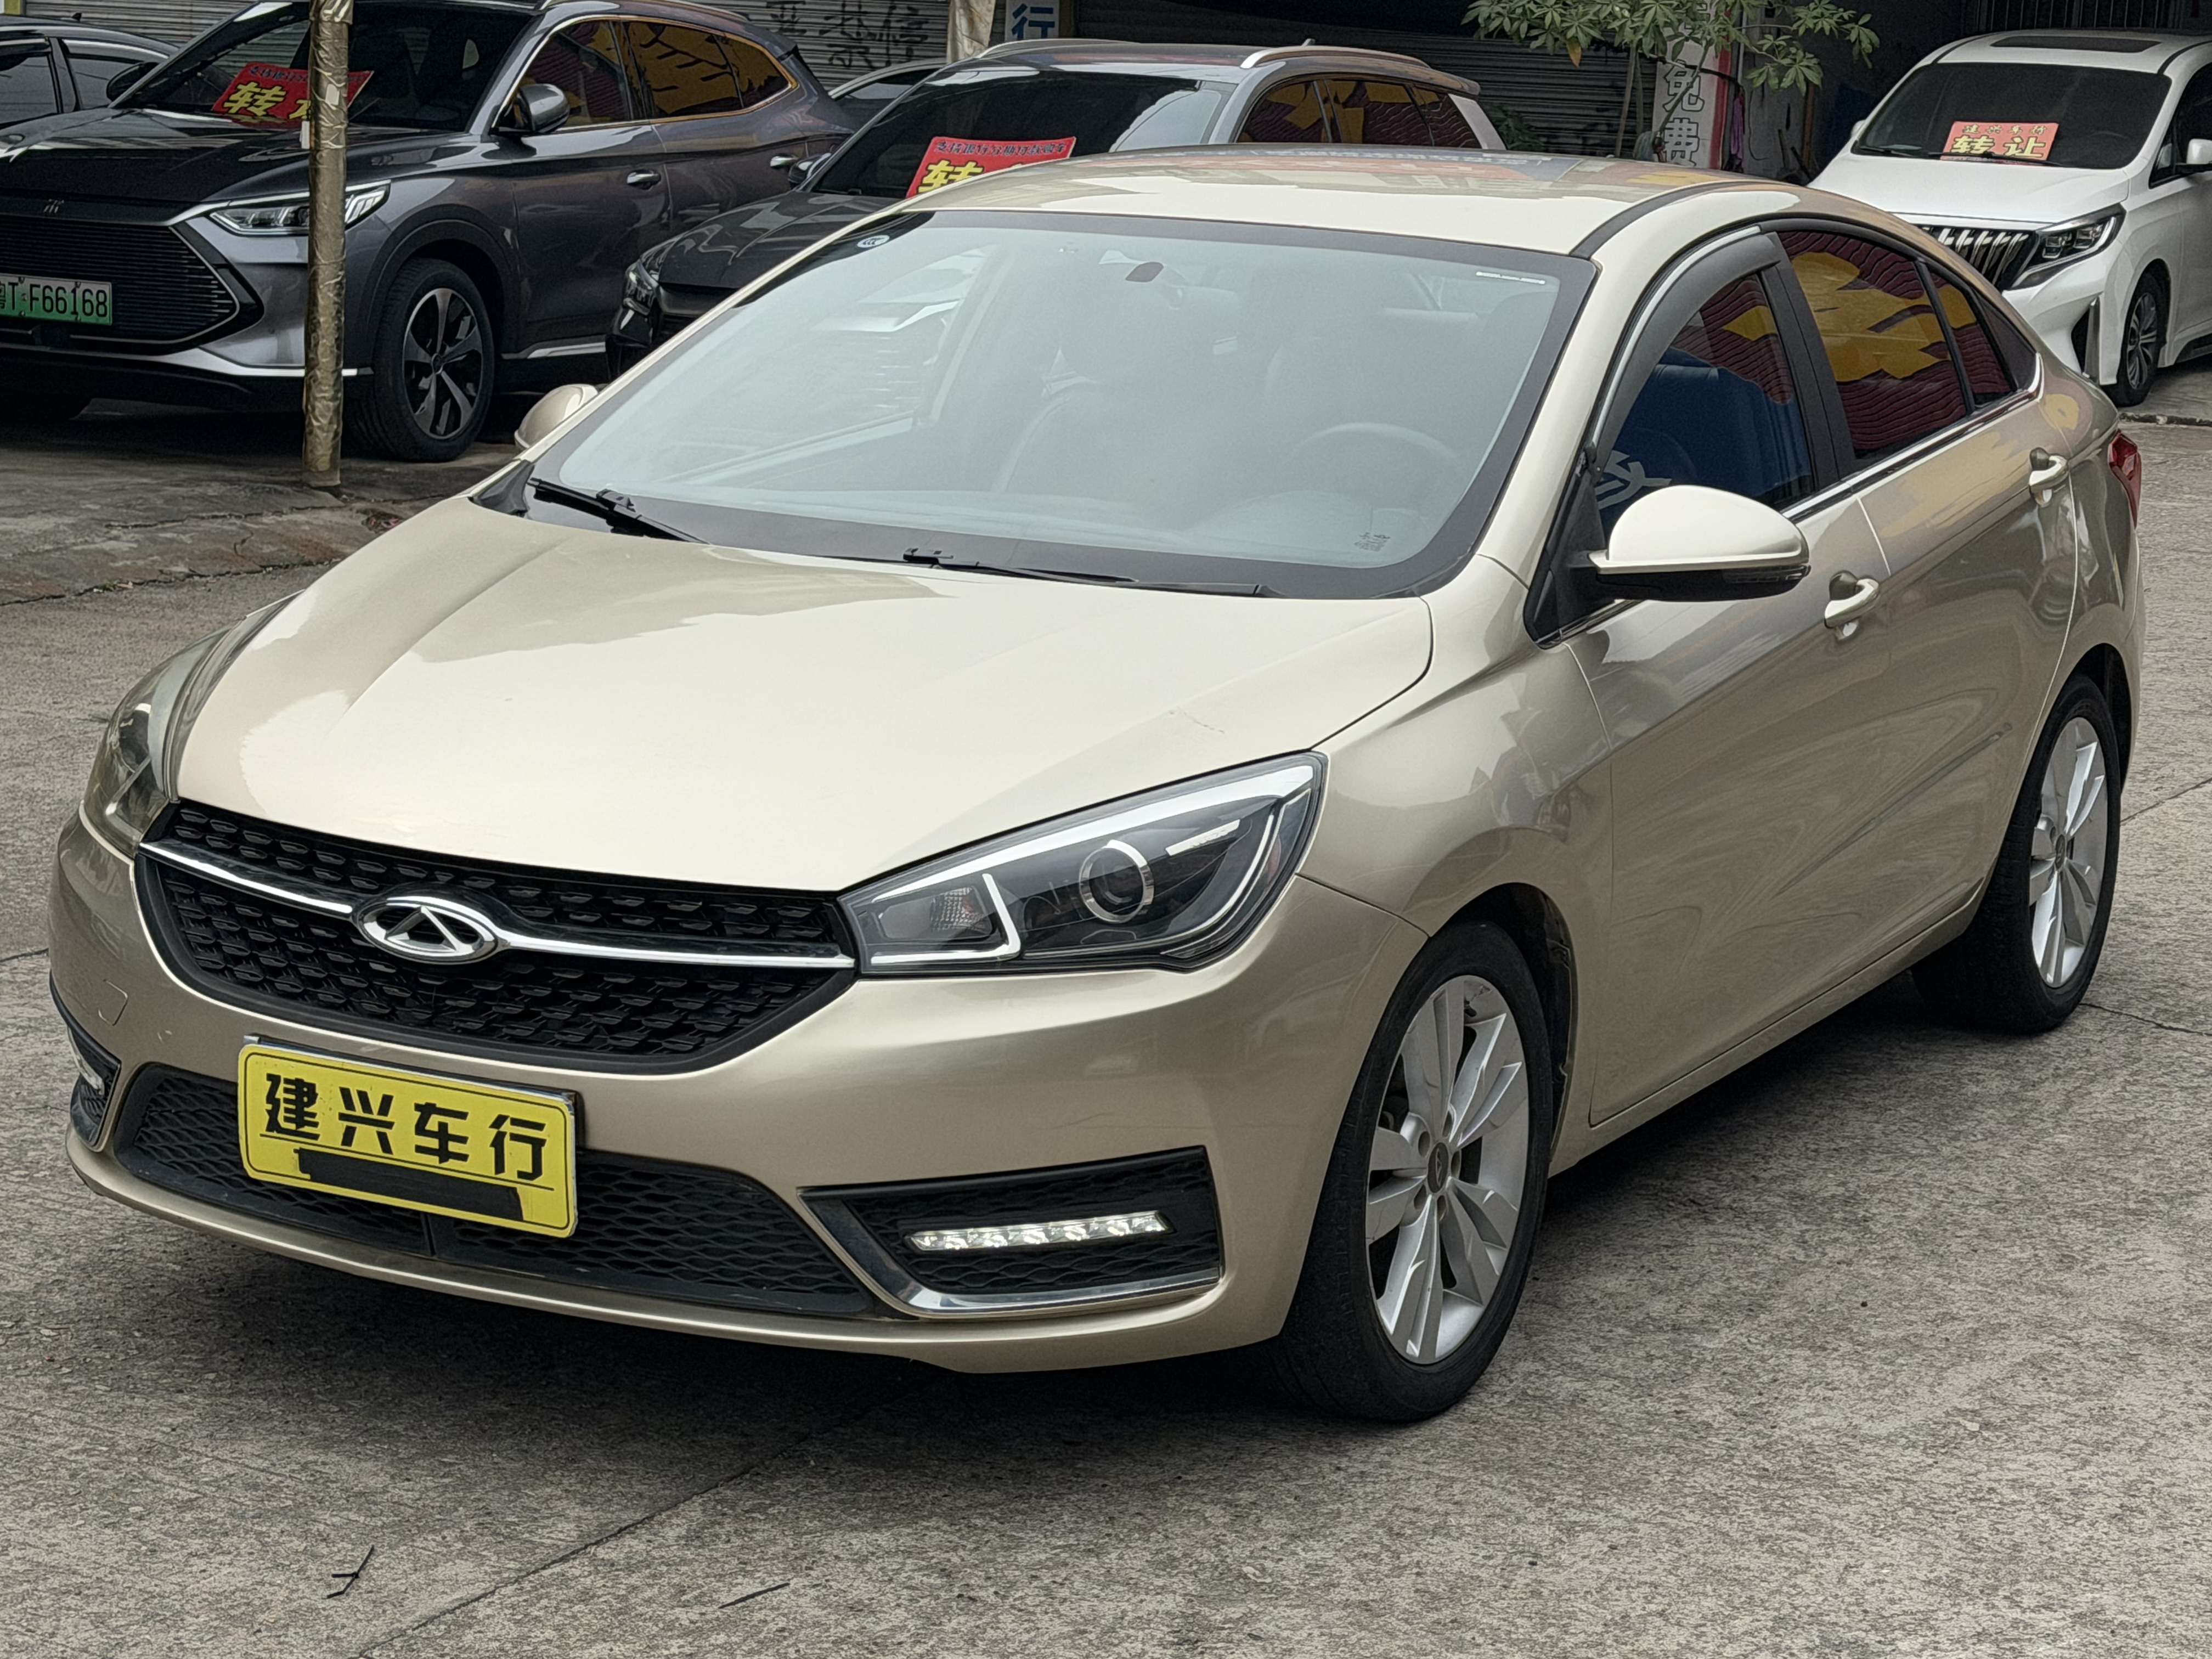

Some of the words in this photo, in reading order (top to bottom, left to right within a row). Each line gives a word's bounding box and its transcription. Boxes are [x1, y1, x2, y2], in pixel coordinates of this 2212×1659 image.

[1012, 3, 1055, 40] 行
[1662, 59, 1705, 167] 免费
[1950, 136, 2046, 157] 转让
[264, 1073, 547, 1182] 建兴车行
